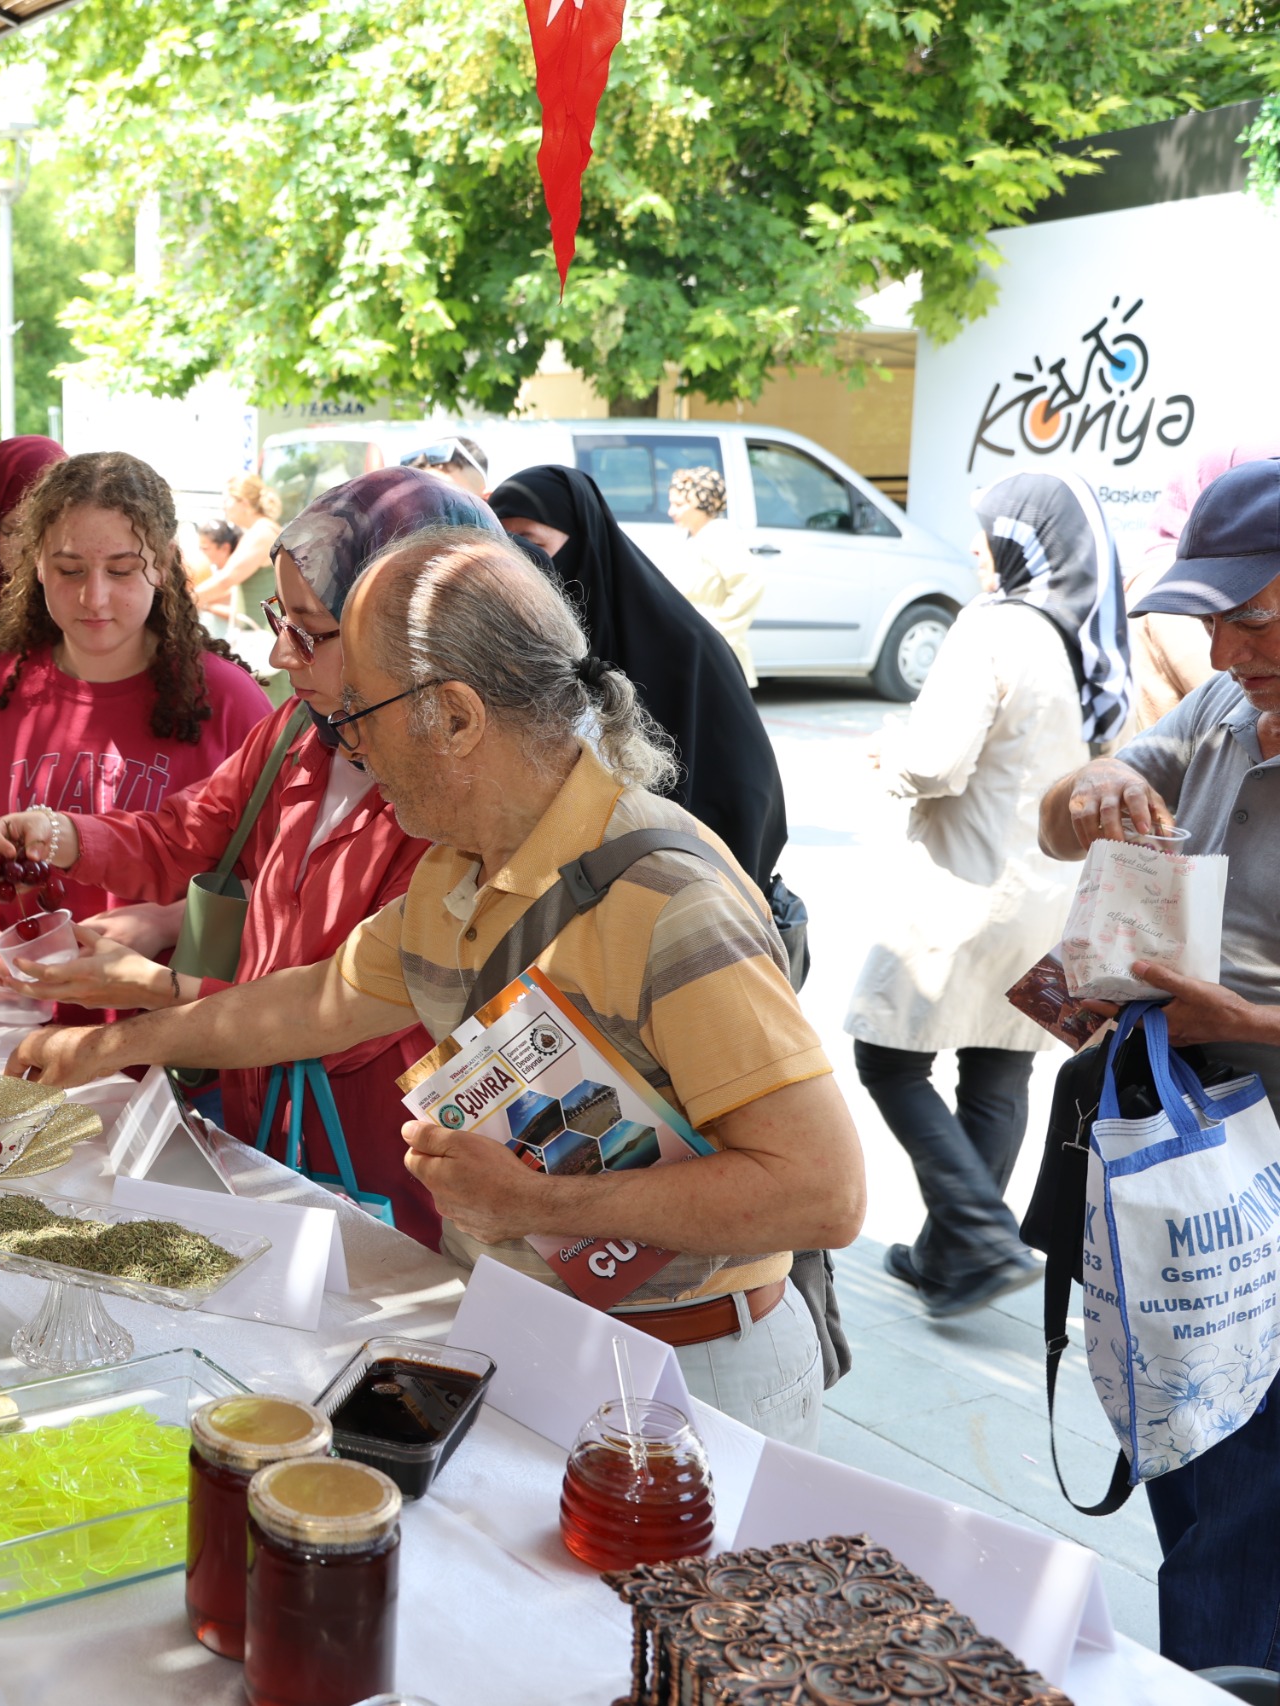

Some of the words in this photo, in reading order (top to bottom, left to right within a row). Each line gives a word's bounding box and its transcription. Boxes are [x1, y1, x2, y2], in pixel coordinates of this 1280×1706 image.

[9, 751, 170, 815] MAVİ
[1110, 852, 1136, 868] afiyet
[1136, 859, 1159, 876] olsun
[1107, 910, 1137, 927] afiyet
[1136, 920, 1164, 939] olsun
[515, 1052, 535, 1069] Devam
[521, 1056, 544, 1075] Ediyoruz
[454, 1066, 516, 1119] ÇUMRA
[560, 1235, 598, 1262] Geçmiş
[588, 1238, 648, 1278] ÇU
[1161, 1265, 1223, 1283] Gsm:
[1228, 1242, 1272, 1273] 0535
[1139, 1291, 1230, 1314] ULUBATLI
[1233, 1269, 1277, 1300] HASAN
[1173, 1293, 1277, 1340] Mahallemizi
